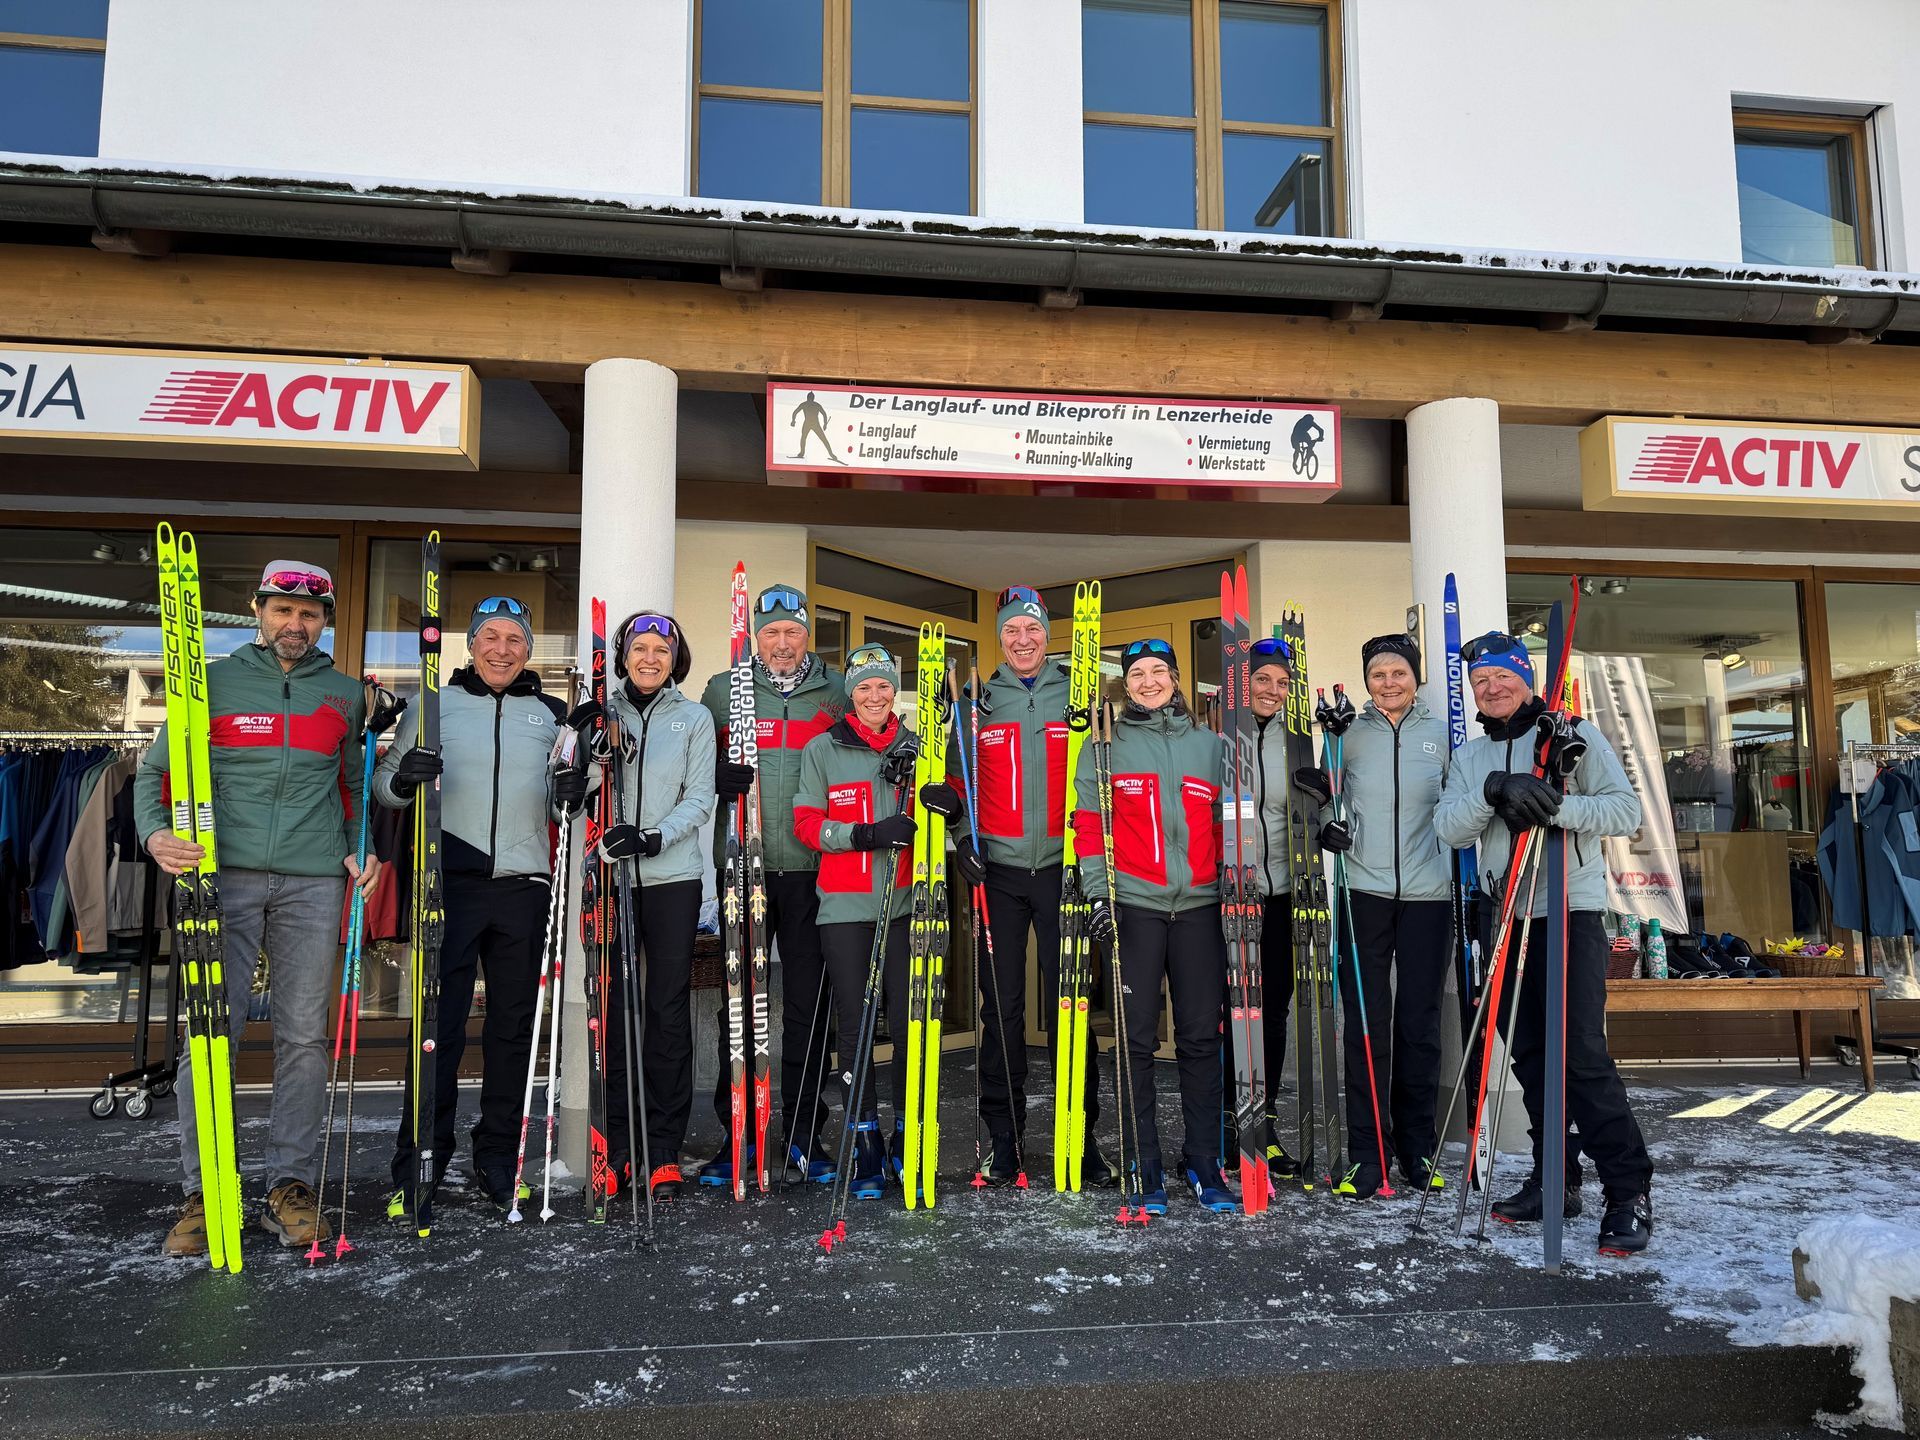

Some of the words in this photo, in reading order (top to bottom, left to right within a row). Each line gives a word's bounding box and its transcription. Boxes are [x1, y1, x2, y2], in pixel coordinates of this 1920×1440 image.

[215, 372, 451, 435] ACTIV
[849, 393, 886, 410] Der
[891, 395, 987, 417] Langlauf-
[992, 400, 1031, 416] und
[1036, 402, 1126, 422] Bikeprofi
[1131, 405, 1150, 421] in
[1156, 407, 1273, 425] Lenzerheide
[858, 422, 917, 441] Langlauf
[1025, 429, 1113, 447] Mountainbike
[1198, 435, 1271, 454] Vermietung
[858, 443, 959, 462] Langlaufschule
[1025, 450, 1133, 470] Running-Walking
[1199, 455, 1266, 471] Werkstatt
[1686, 436, 1861, 489] ACTIV
[162, 581, 183, 698] FISCHER
[183, 589, 205, 703] FISCHER
[1227, 663, 1235, 710] ROSSIGNOL
[1242, 659, 1250, 708] ROSSIGNOL
[1294, 636, 1312, 737] FISCHER
[1447, 652, 1468, 746] SALOMON
[241, 716, 276, 725] ACTIV
[918, 667, 930, 761] FISCHER
[834, 788, 857, 798] ACTIV
[1120, 779, 1144, 787] ACTIV
